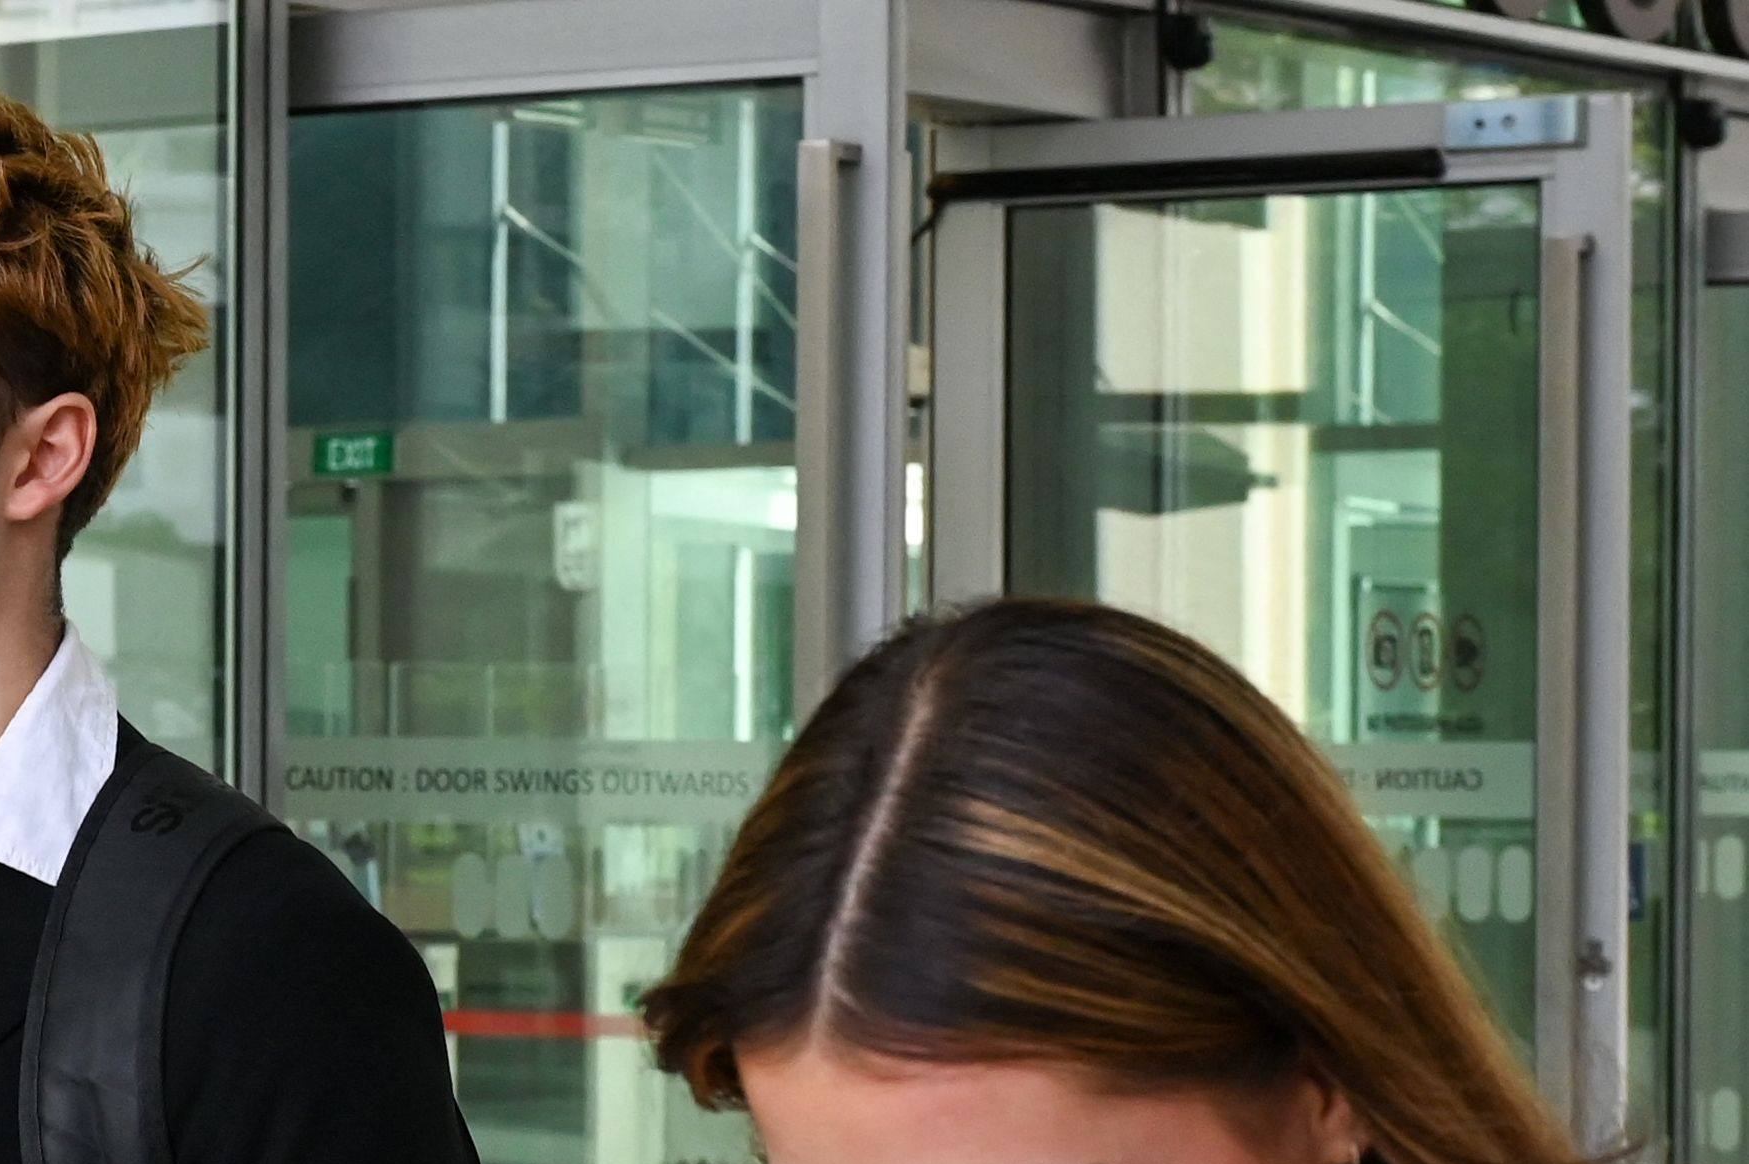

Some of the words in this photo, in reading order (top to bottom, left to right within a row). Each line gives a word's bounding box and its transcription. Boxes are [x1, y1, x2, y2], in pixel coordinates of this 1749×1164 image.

[327, 437, 376, 471] EXIT
[284, 764, 394, 792] CAUTION
[415, 766, 488, 794] DOOR
[493, 766, 594, 795] SWINGS
[602, 767, 749, 797] OUTWARDS
